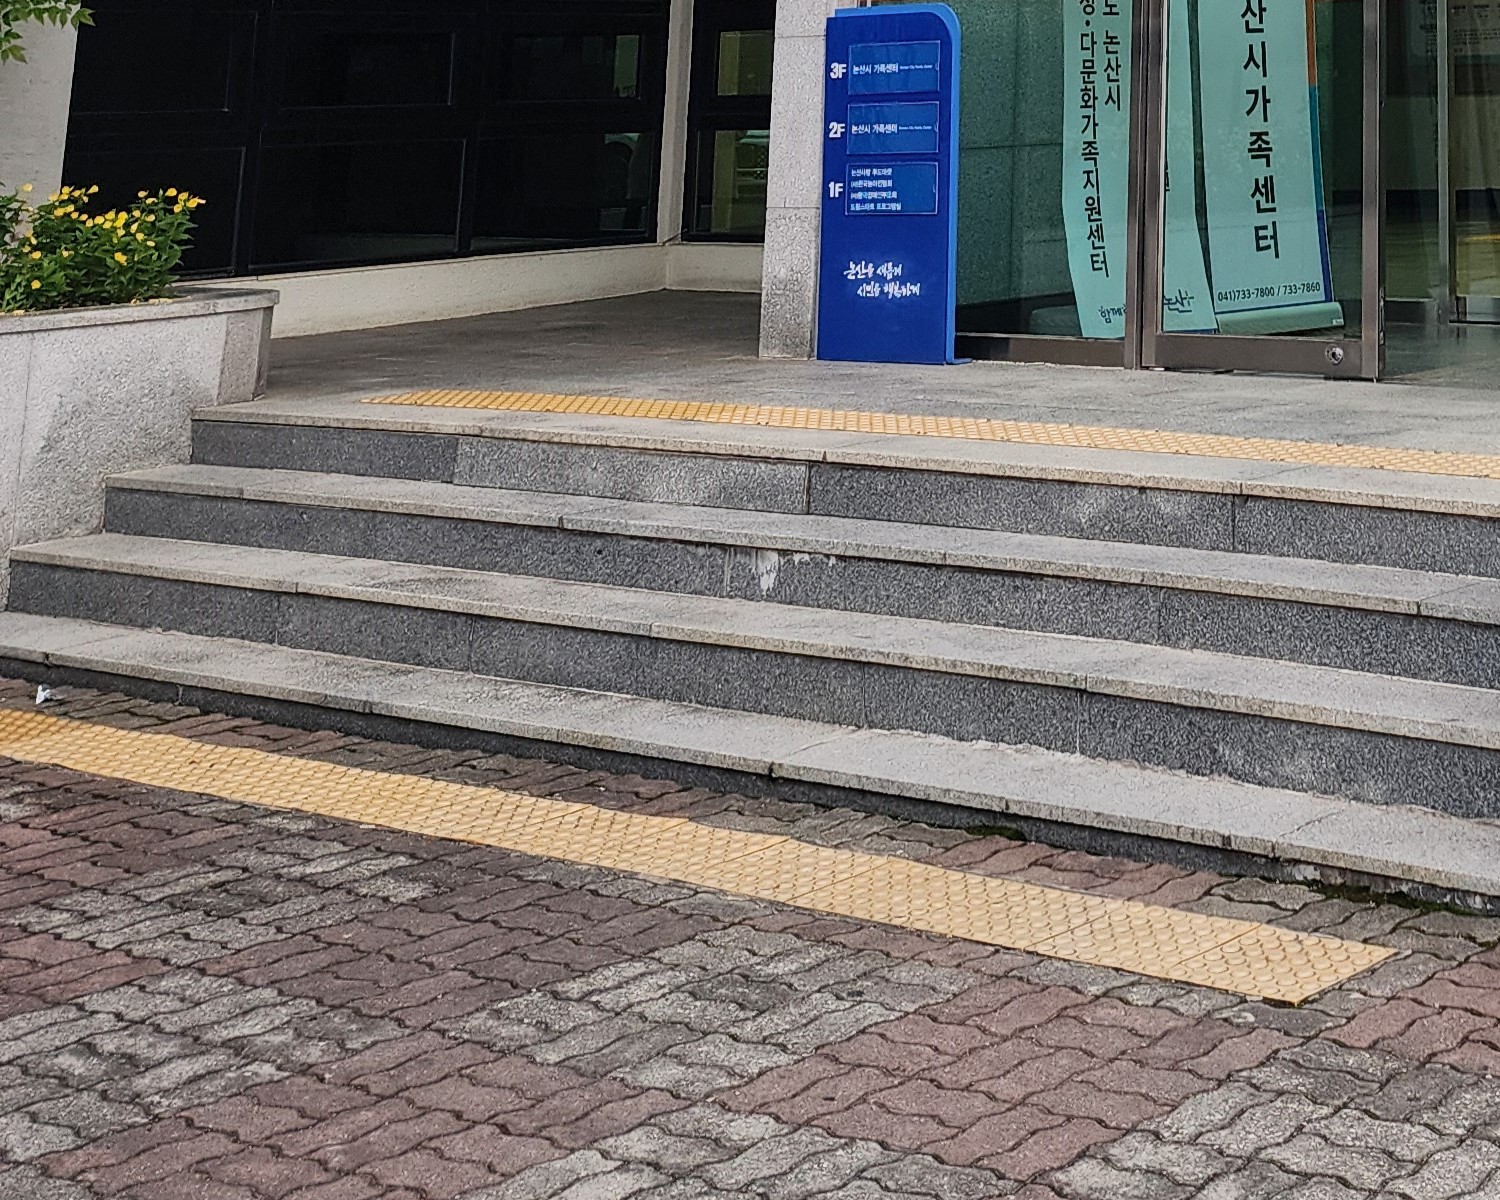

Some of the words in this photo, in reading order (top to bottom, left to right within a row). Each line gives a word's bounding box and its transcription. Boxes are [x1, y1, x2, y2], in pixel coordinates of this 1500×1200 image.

[830, 62, 847, 79] 3F
[853, 64, 872, 75] 논산시
[1103, 30, 1121, 111] 논산시
[829, 121, 846, 138] 2F
[851, 124, 871, 135] 논산시
[828, 181, 844, 198] 1F
[843, 260, 875, 279] 논산을
[876, 262, 902, 280] 새롭게
[857, 281, 881, 297] 시민을
[883, 280, 920, 299] 행복하게
[1217, 286, 1275, 302] 041)733-7800
